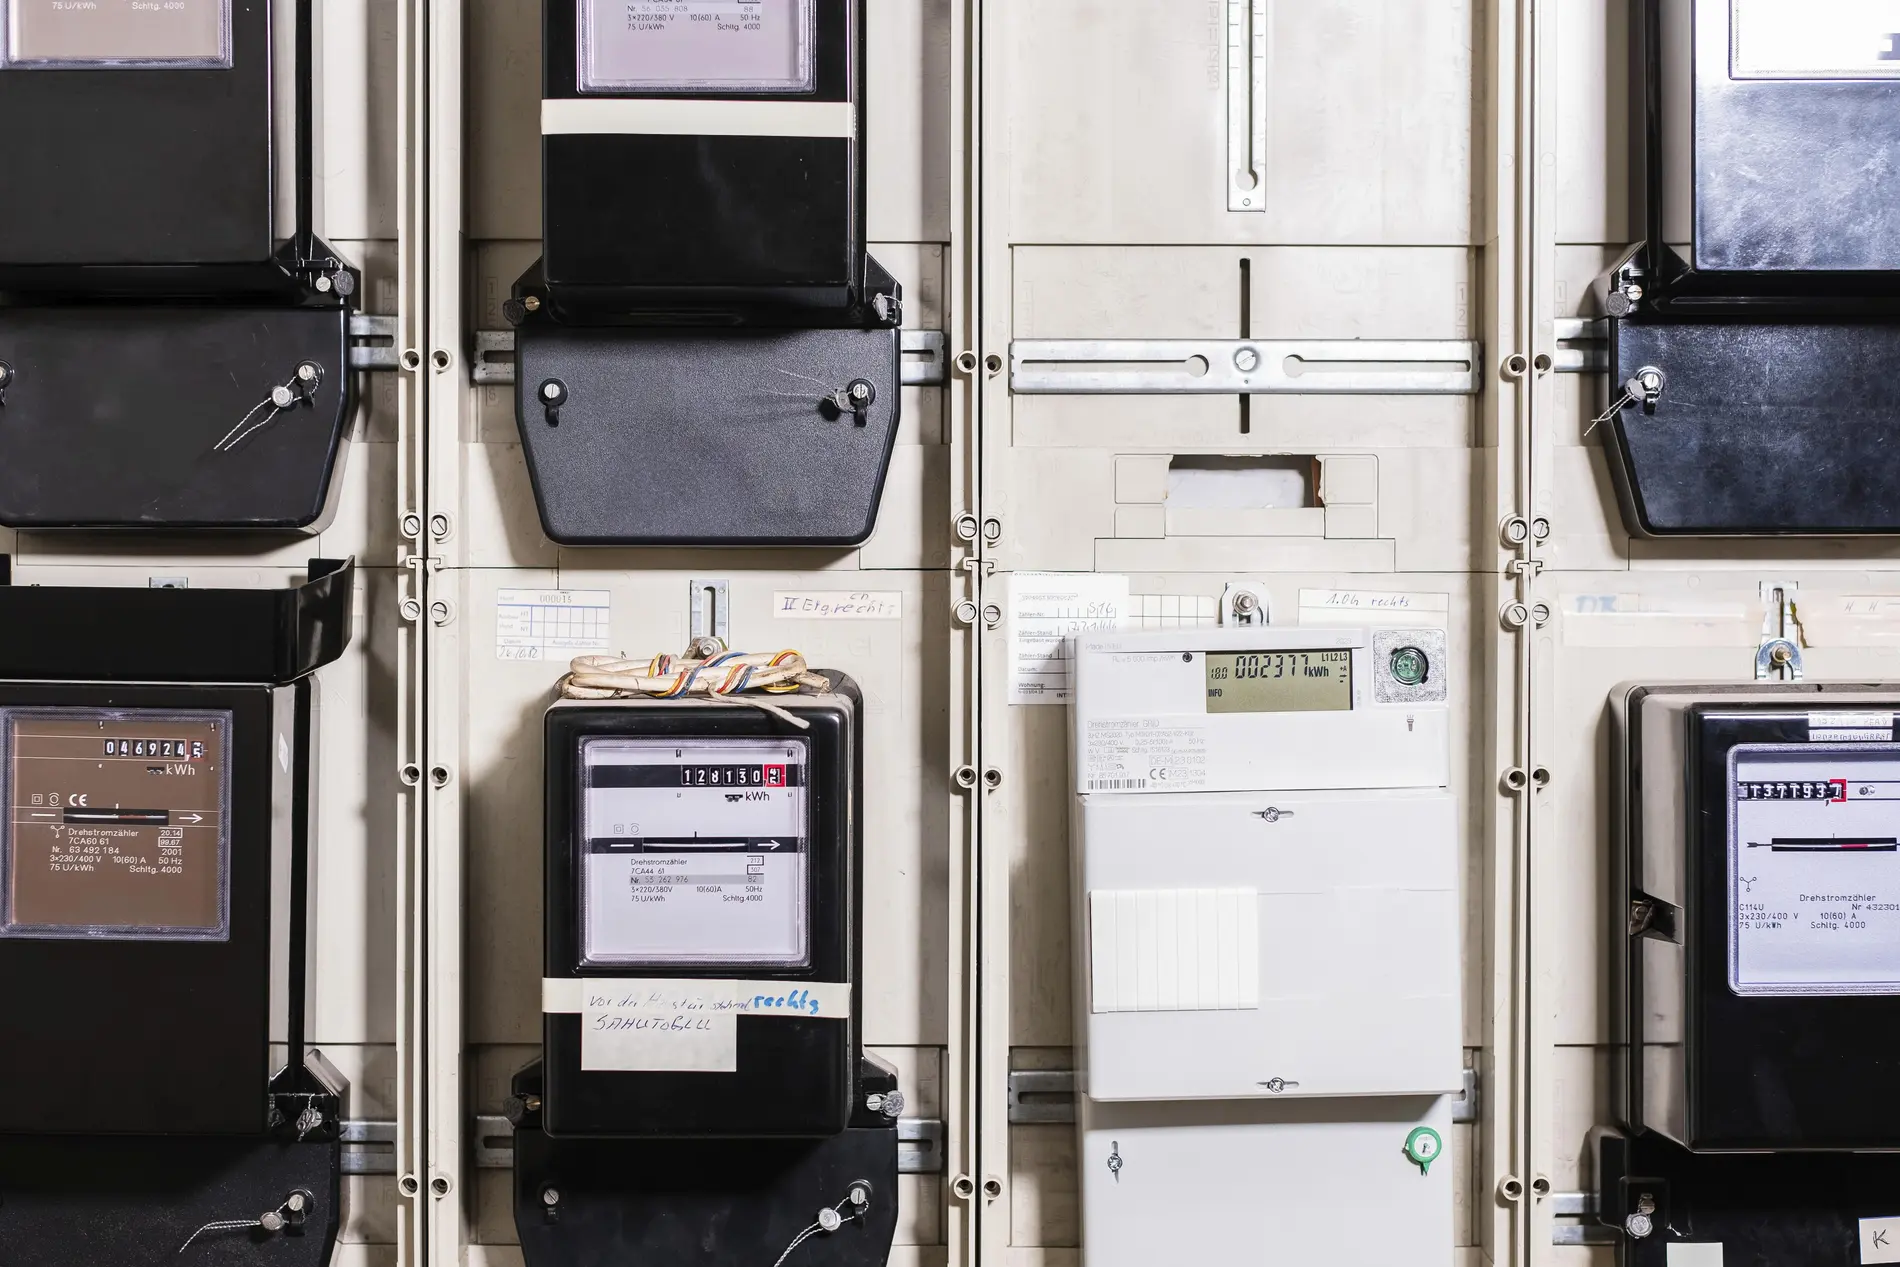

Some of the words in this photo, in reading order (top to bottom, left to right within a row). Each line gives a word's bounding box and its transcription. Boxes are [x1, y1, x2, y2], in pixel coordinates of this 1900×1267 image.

[52, 2, 64, 10] 75
[164, 2, 185, 10] 4000
[1322, 653, 1330, 662] L1
[1330, 653, 1339, 662] L2
[1340, 653, 1348, 662] L3
[1234, 655, 1308, 679] 002377
[1308, 666, 1330, 678] kWh
[1208, 688, 1222, 697] INFO
[166, 764, 196, 776] kWh
[745, 791, 770, 802] kWh
[68, 828, 139, 837] Drehstromzähler
[68, 837, 98, 845] 7CA60
[112, 856, 138, 864] 10(60)
[171, 857, 182, 865] Hz
[62, 864, 94, 872] U/kWh
[129, 865, 158, 875] Schltg.
[1799, 894, 1876, 902] Drehstromzähler
[1820, 912, 1846, 920] 10(60)
[1810, 922, 1840, 930] Schltg.
[1872, 1229, 1890, 1250] K
